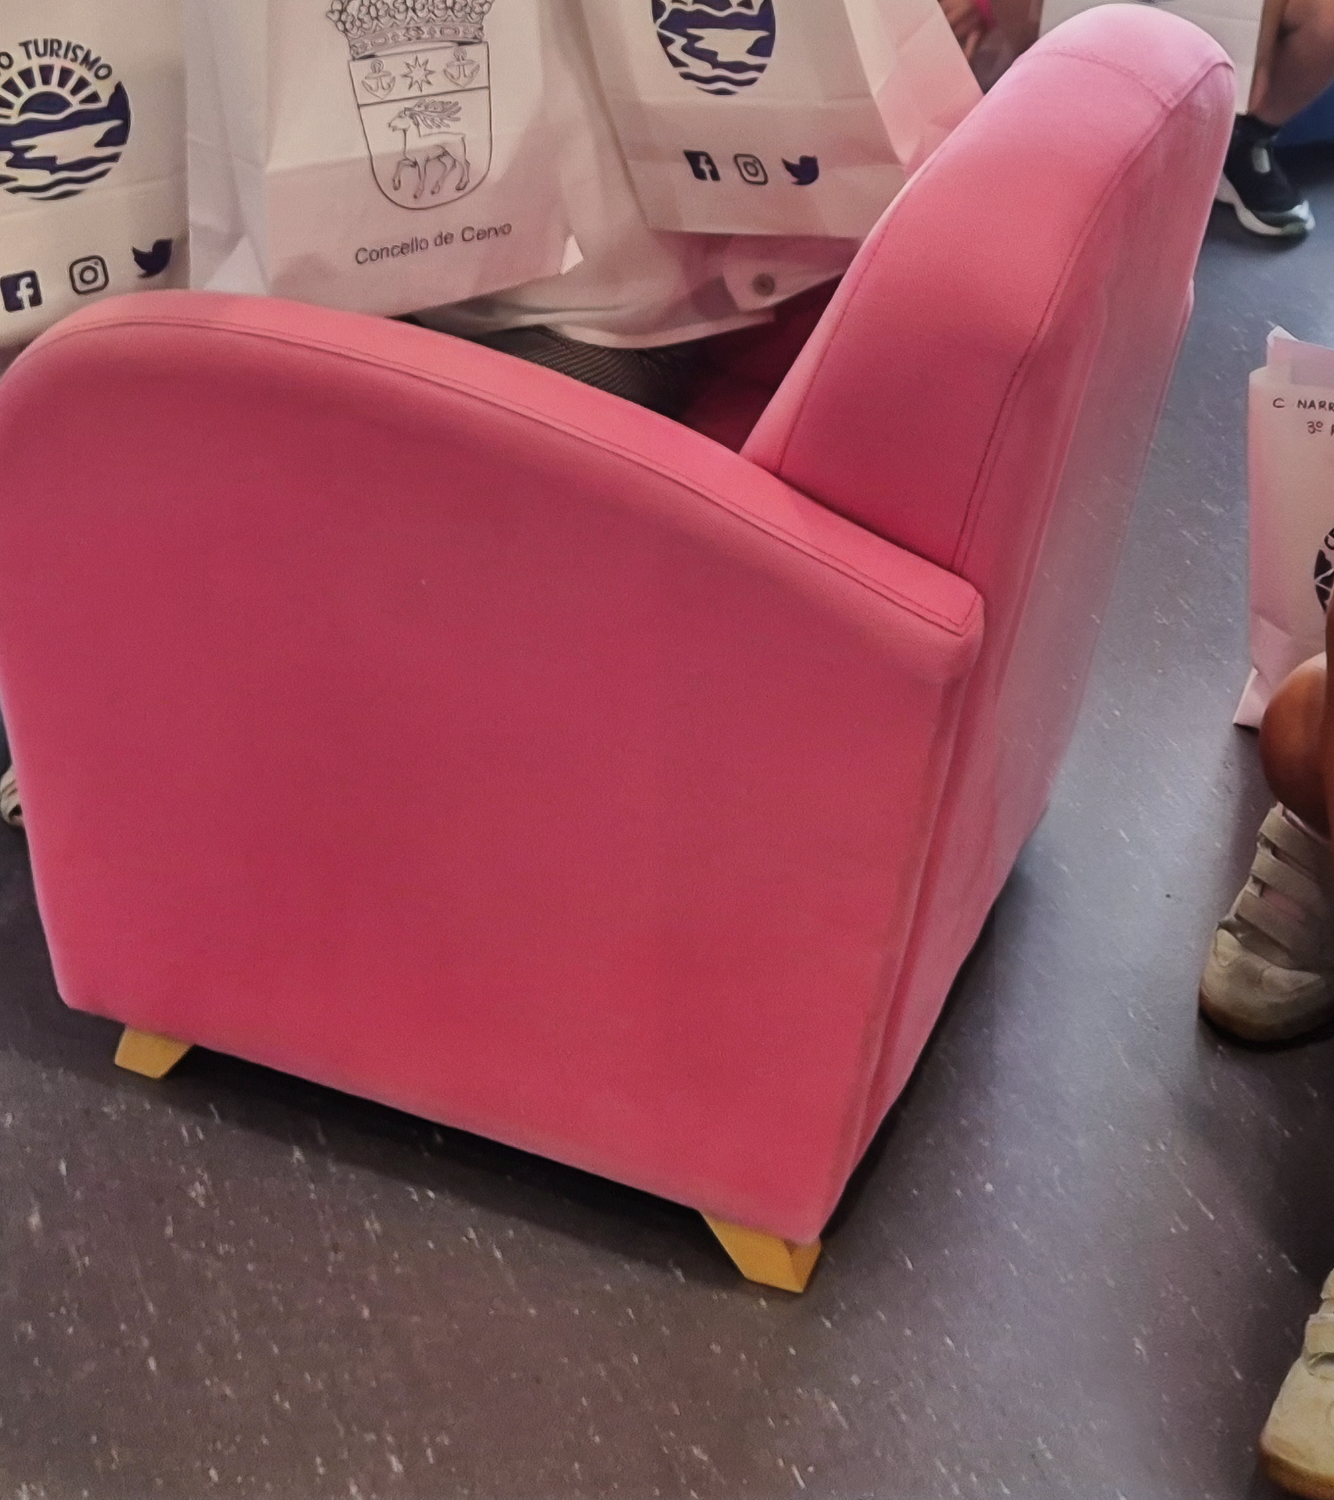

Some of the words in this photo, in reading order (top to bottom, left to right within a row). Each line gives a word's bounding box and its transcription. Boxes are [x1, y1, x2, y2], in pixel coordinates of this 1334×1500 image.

[18, 37, 113, 81] TURISMO
[355, 237, 429, 265] Concello
[434, 231, 454, 247] de
[461, 223, 512, 242] Cervo
